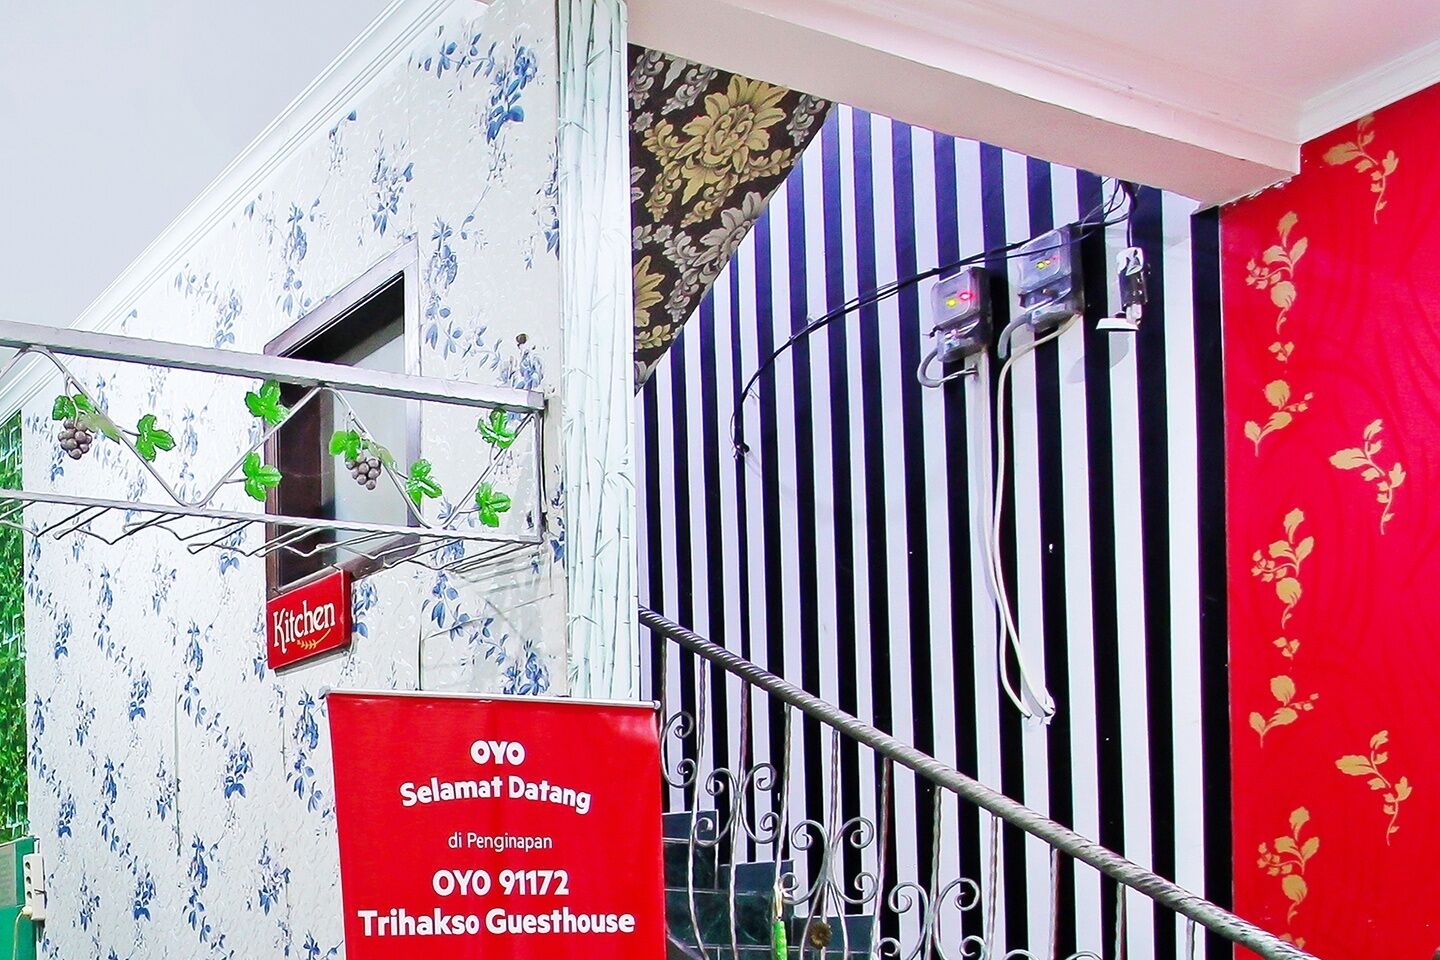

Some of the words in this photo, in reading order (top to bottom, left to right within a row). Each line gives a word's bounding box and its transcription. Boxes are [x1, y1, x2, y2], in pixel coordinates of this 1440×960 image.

[273, 600, 335, 654] Kitchen
[470, 740, 525, 765] OYO
[399, 775, 503, 807] Selamat
[509, 775, 592, 815] Datang
[448, 832, 462, 849] di
[467, 832, 552, 852] Penginapan
[432, 869, 492, 896] OYO
[498, 869, 569, 896] 91172
[357, 908, 480, 937] Trihakso
[485, 907, 636, 935] Guesthouse
